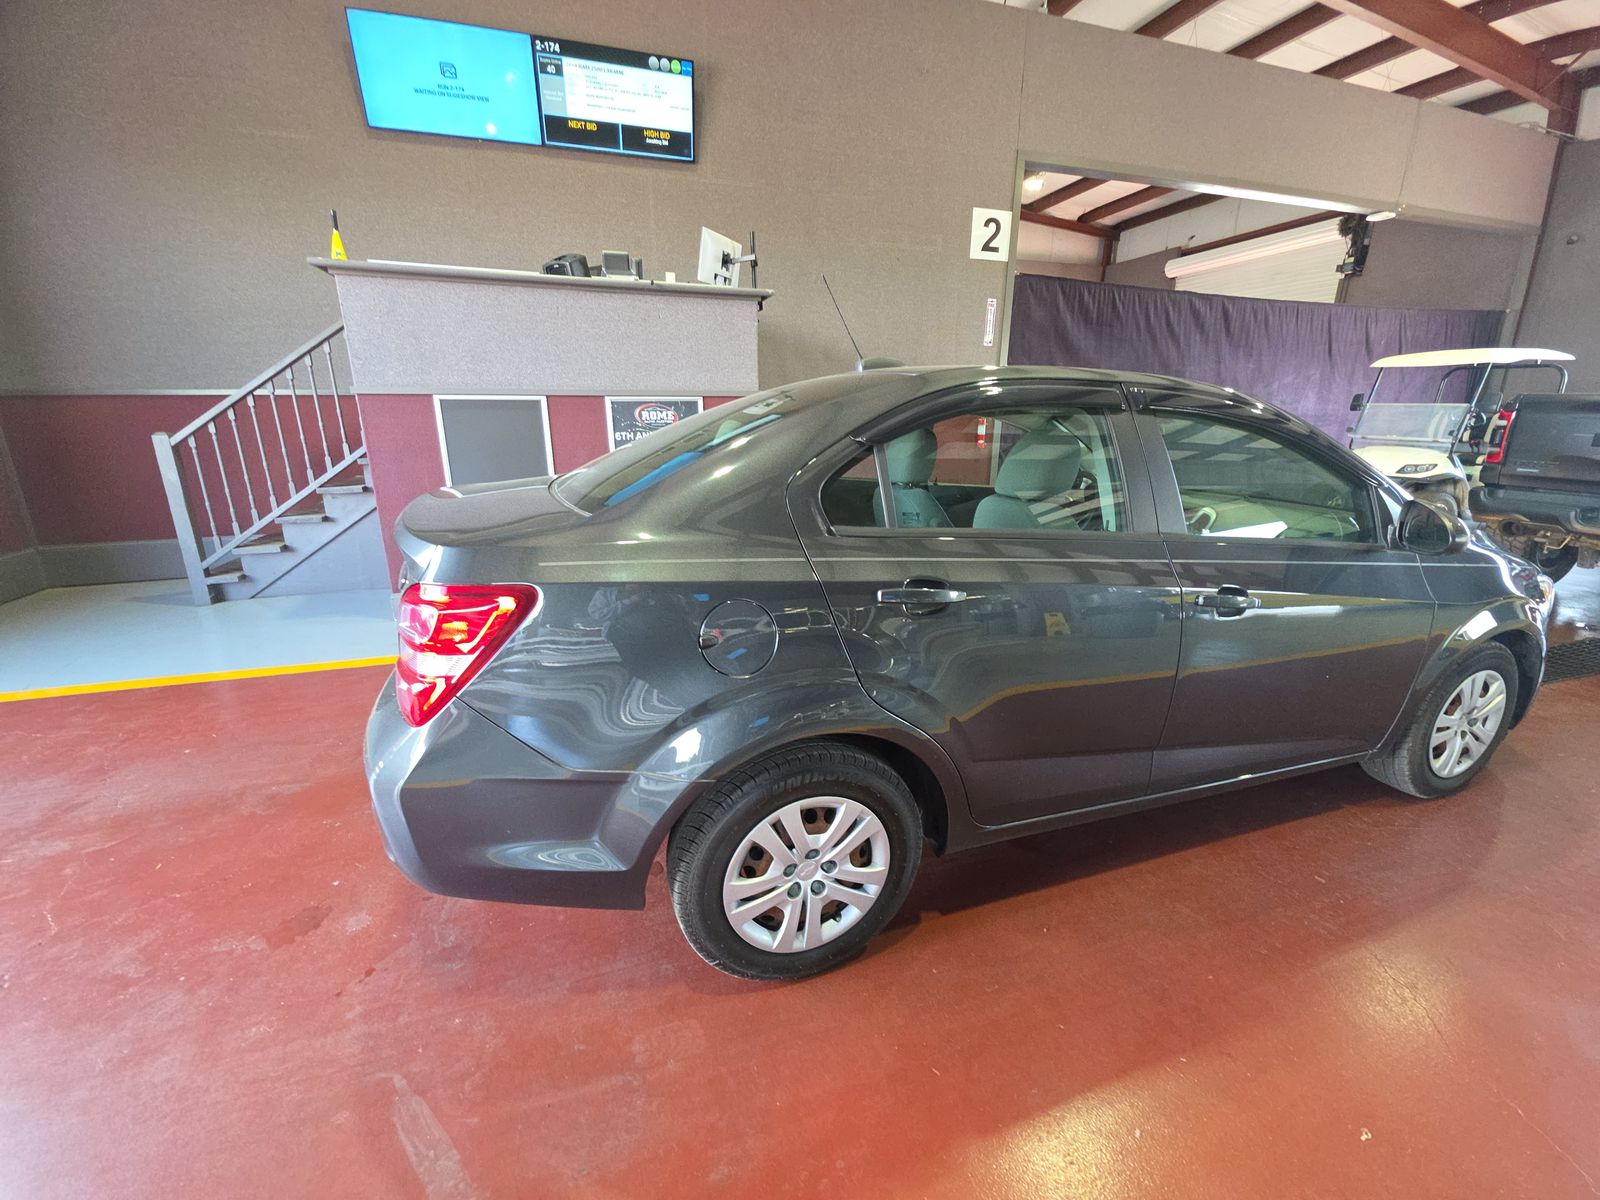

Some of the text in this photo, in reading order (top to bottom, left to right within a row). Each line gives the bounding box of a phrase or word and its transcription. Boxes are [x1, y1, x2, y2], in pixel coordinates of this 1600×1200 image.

[413, 87, 437, 96] WAITING
[446, 92, 476, 101] SLIDESHOW
[476, 95, 490, 103] VIEW
[568, 120, 598, 131] NEXT BID
[643, 128, 671, 140] HIGH BID
[981, 217, 1002, 253] 2
[641, 411, 675, 420] ROME
[615, 431, 652, 441] 6TH AN
